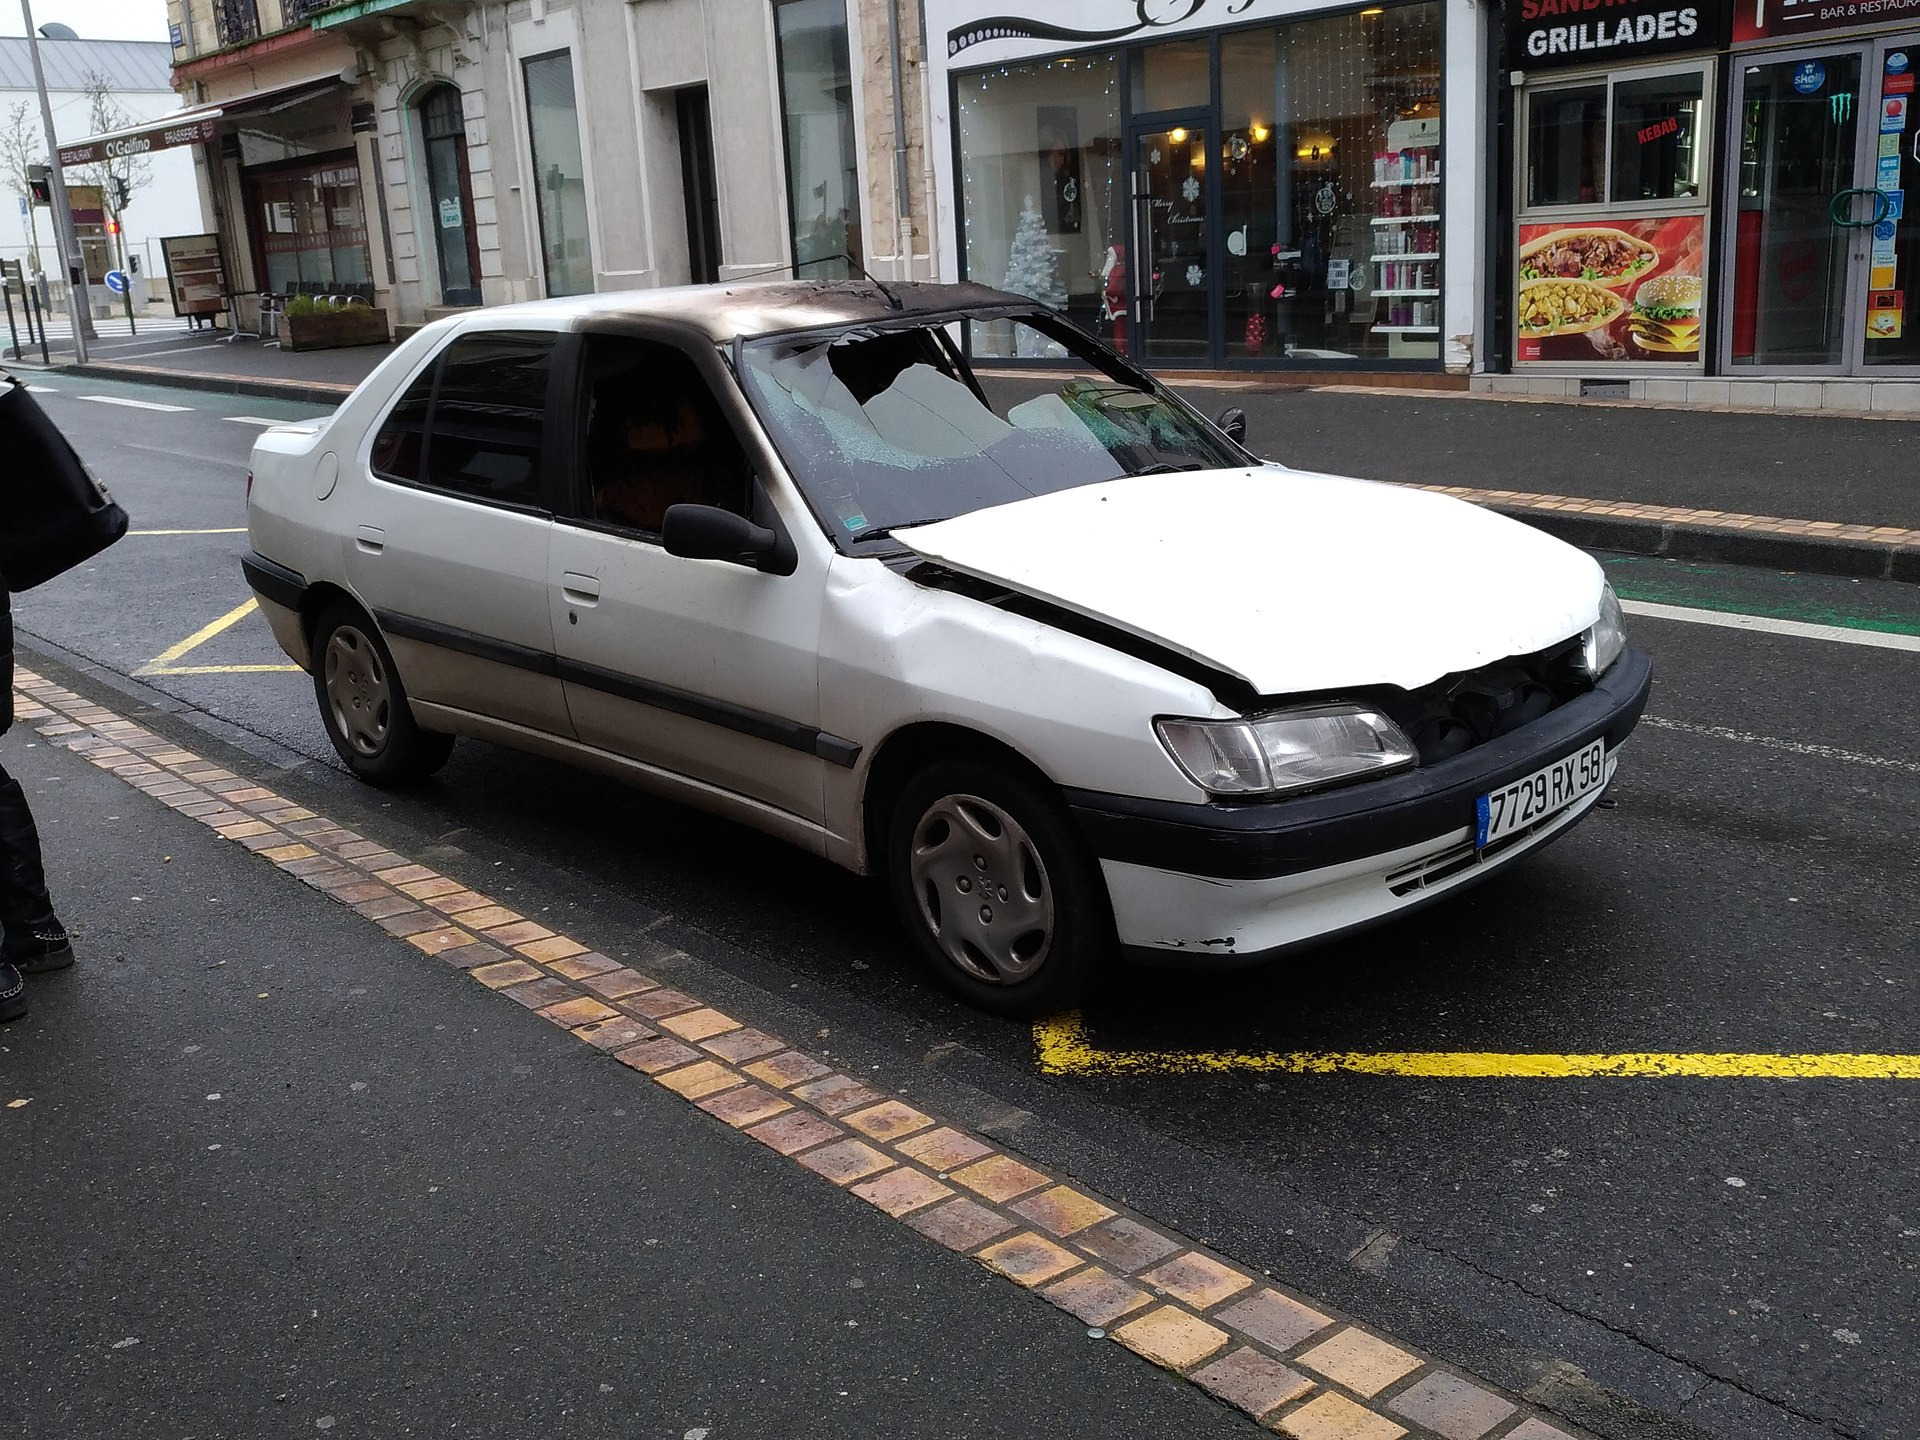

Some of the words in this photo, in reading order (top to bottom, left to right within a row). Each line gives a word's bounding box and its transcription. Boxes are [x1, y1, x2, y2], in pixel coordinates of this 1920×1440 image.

[1820, 5, 1845, 20] BAR
[1847, 4, 1857, 16] &
[1527, 7, 1698, 57] GRILLADES
[1637, 116, 1678, 145] KEBAB
[1491, 774, 1546, 836] 7729
[1551, 758, 1576, 807] RX
[1579, 744, 1600, 790] 58
